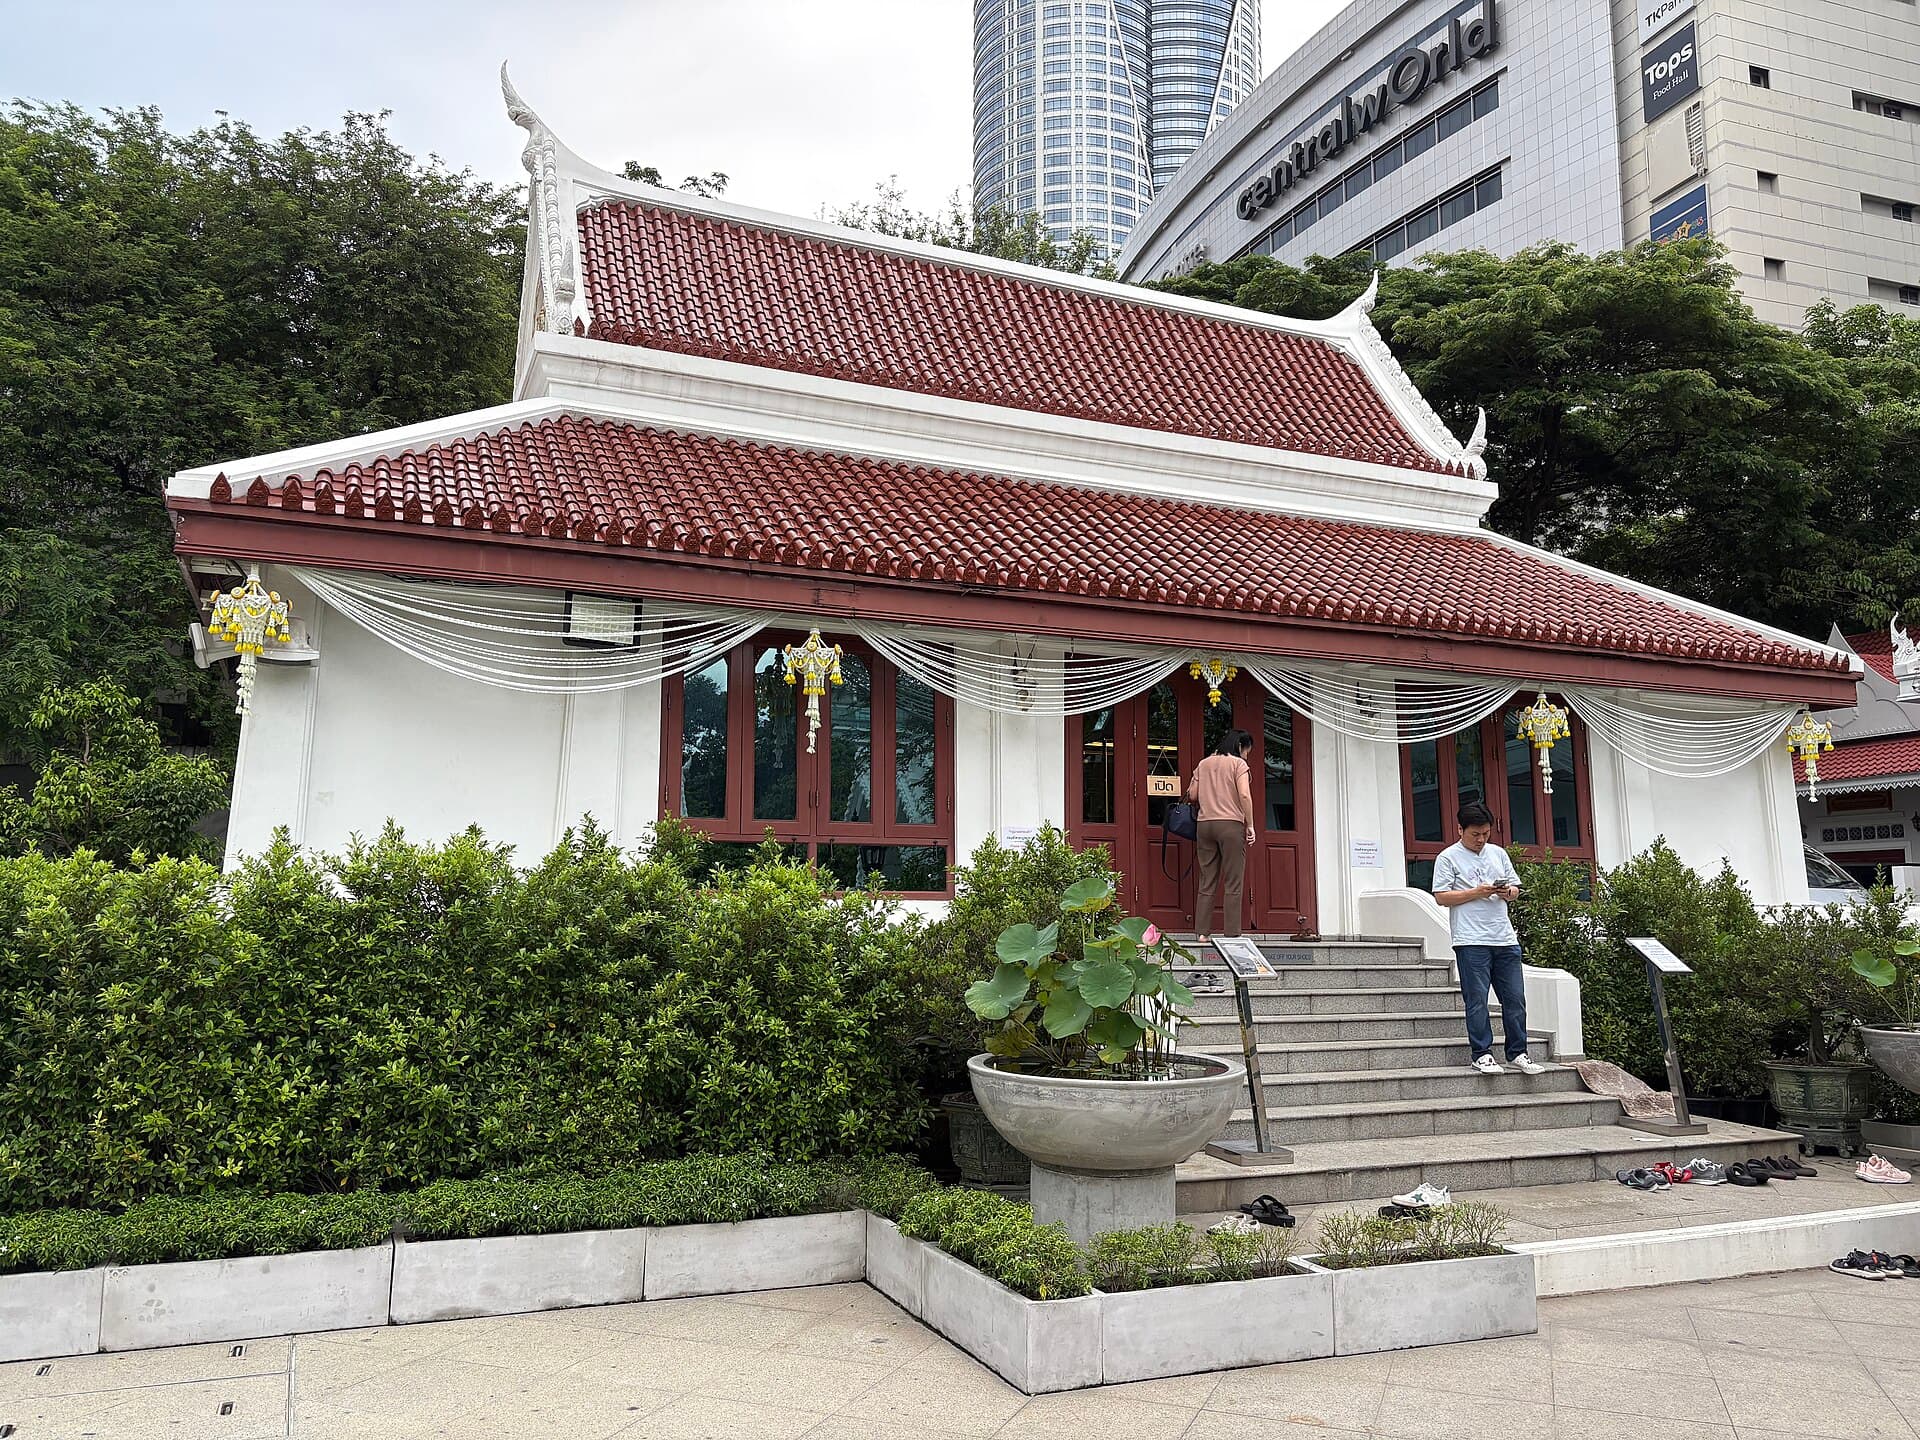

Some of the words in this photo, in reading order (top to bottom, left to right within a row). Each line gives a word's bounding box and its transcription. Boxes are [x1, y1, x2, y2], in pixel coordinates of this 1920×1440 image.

[1644, 0, 1685, 27] TKPar
[1644, 43, 1693, 86] Tops
[1653, 81, 1671, 100] Food
[1671, 69, 1689, 88] Hall
[1154, 780, 1174, 792] เปิด
